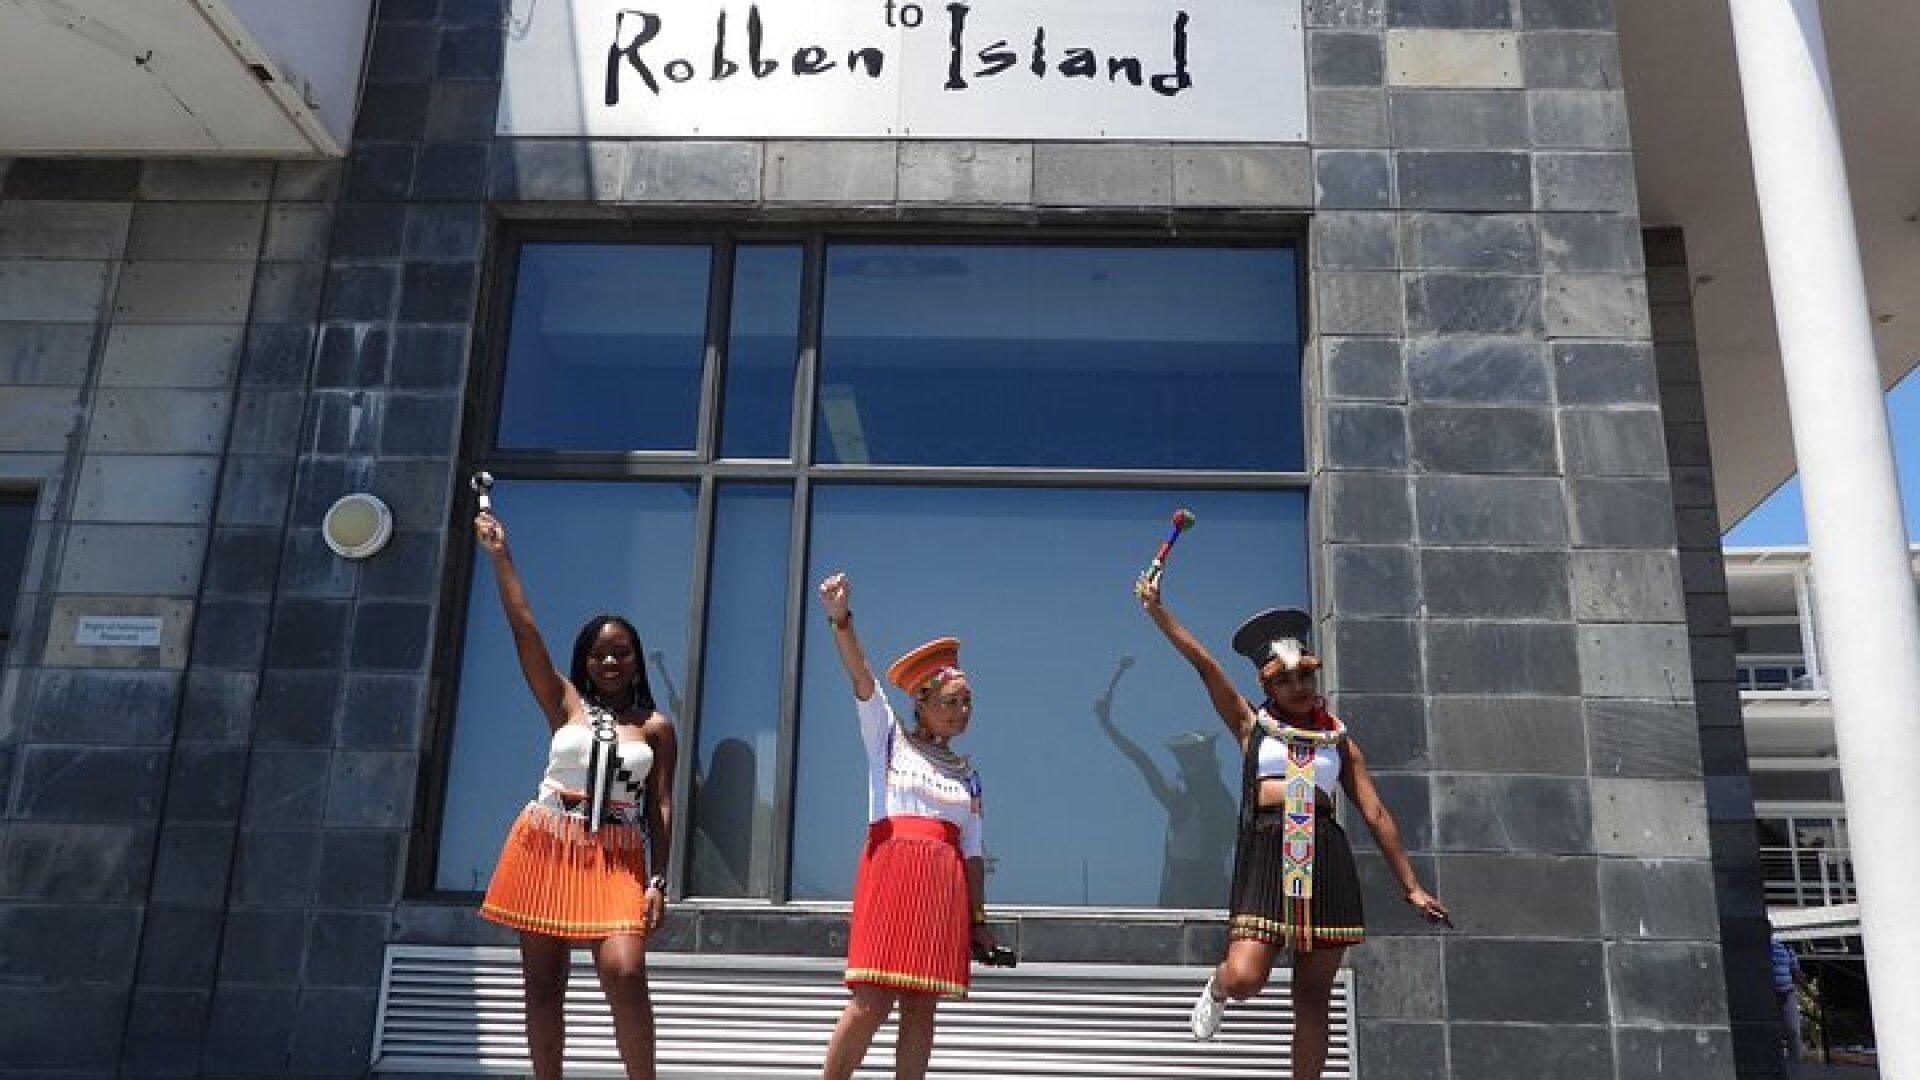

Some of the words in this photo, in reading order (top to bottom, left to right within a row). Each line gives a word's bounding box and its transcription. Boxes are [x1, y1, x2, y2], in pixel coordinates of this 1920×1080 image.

[885, 0, 923, 29] to
[604, 5, 885, 107] Robben
[943, 2, 1193, 97] Island
